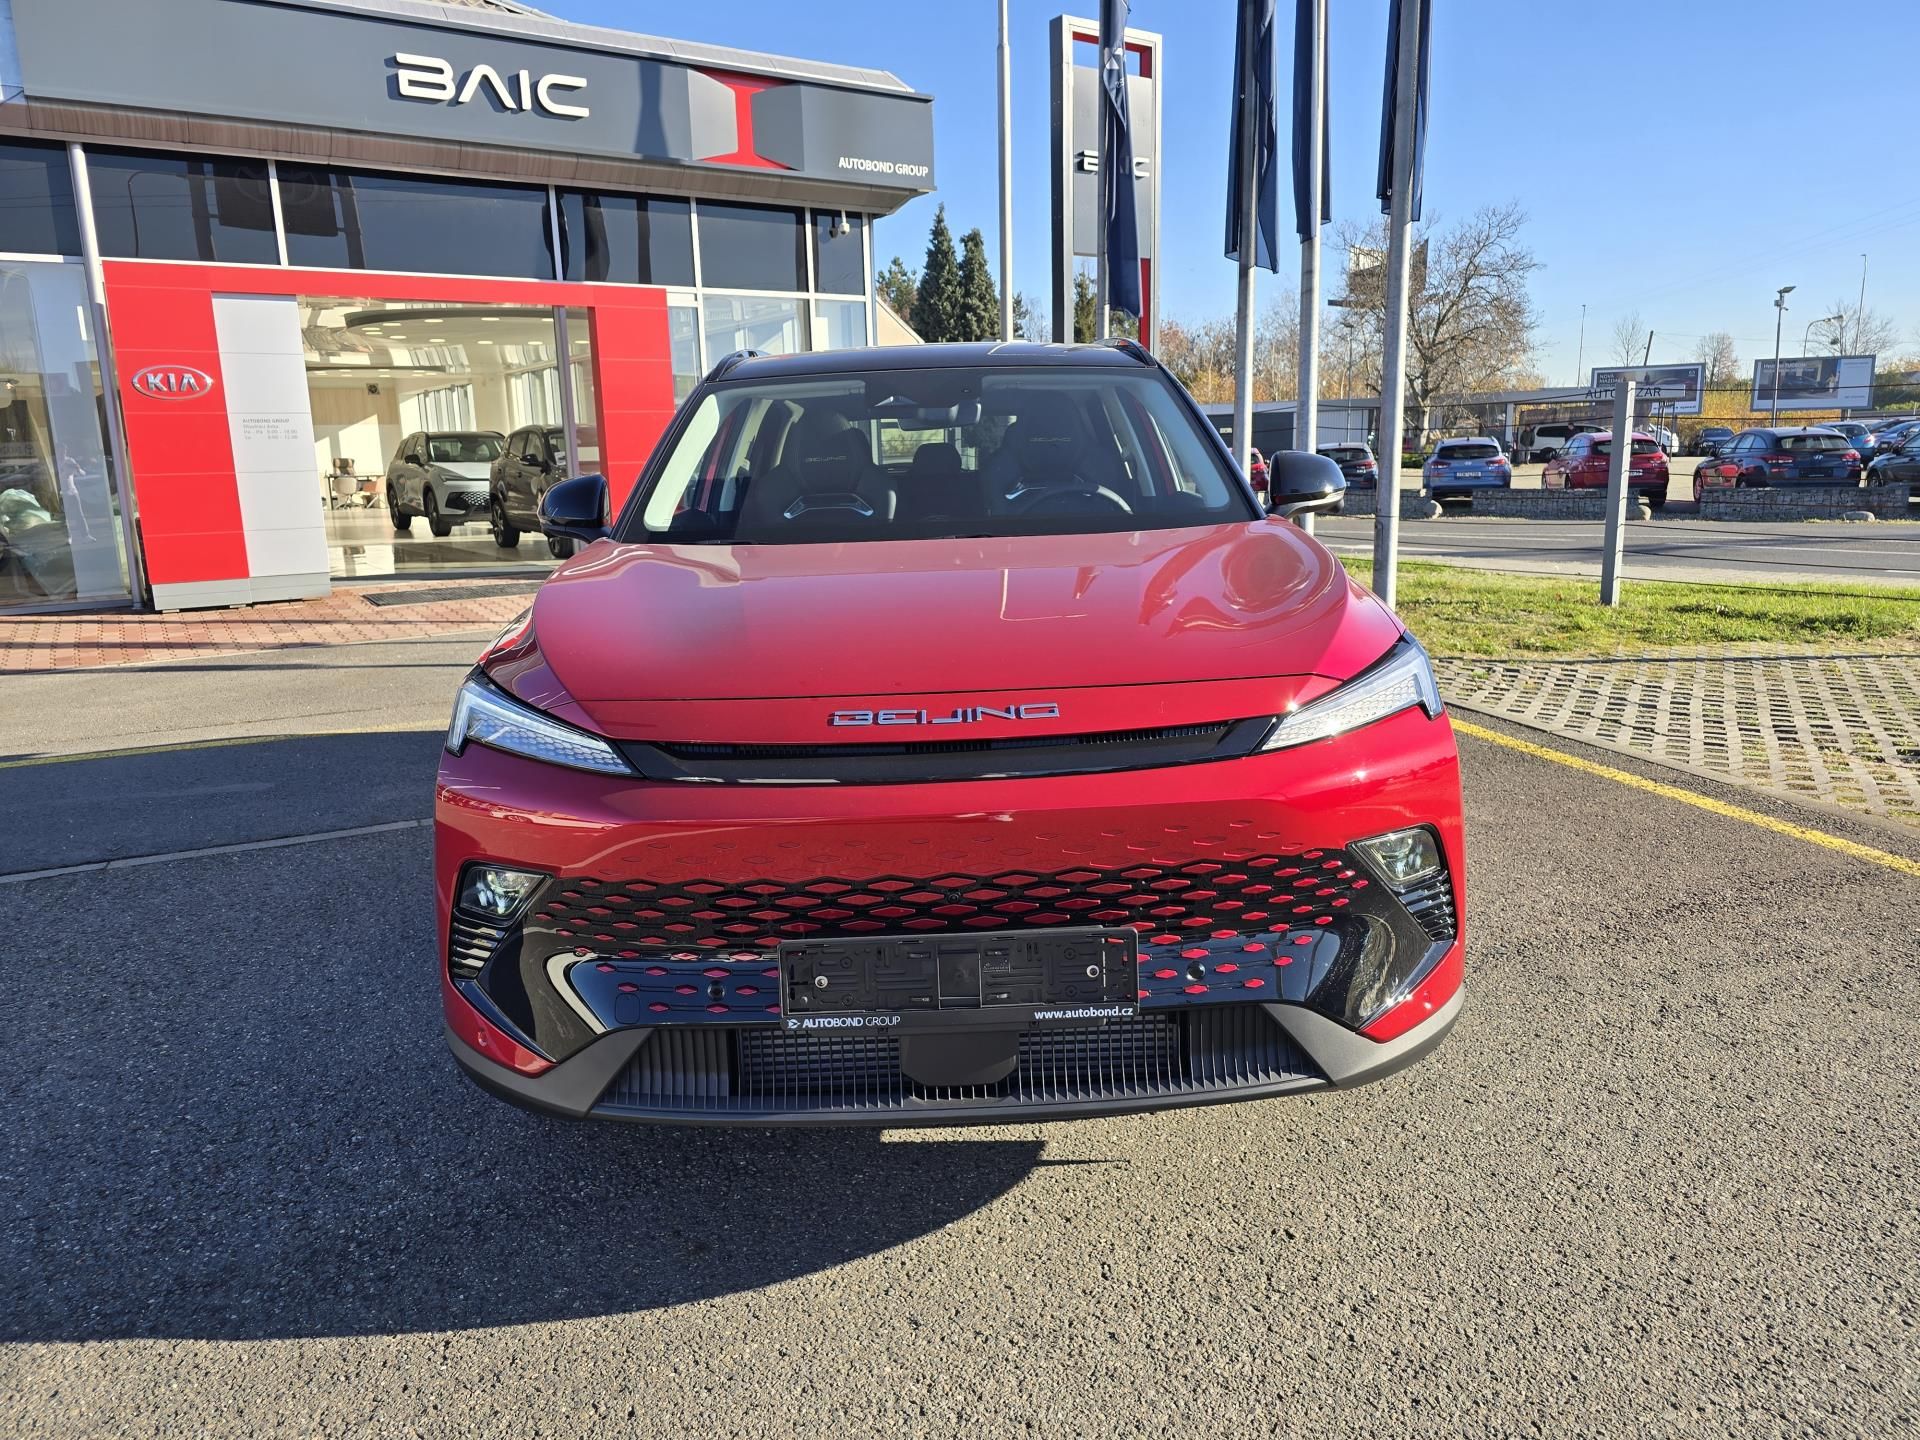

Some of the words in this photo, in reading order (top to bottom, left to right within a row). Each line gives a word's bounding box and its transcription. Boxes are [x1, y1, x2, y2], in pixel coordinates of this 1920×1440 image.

[396, 53, 589, 117] BAIC
[839, 157, 894, 173] AUTOBOND
[895, 164, 928, 177] GROUP
[1083, 149, 1150, 177] BIC
[146, 373, 200, 392] KIA
[1585, 387, 1661, 400] AUTZAR
[834, 703, 1059, 725] BEIJING
[802, 1017, 863, 1028] AUTOBOND
[865, 1016, 900, 1026] GROUP
[1034, 1006, 1133, 1019] www.autobond.cz
